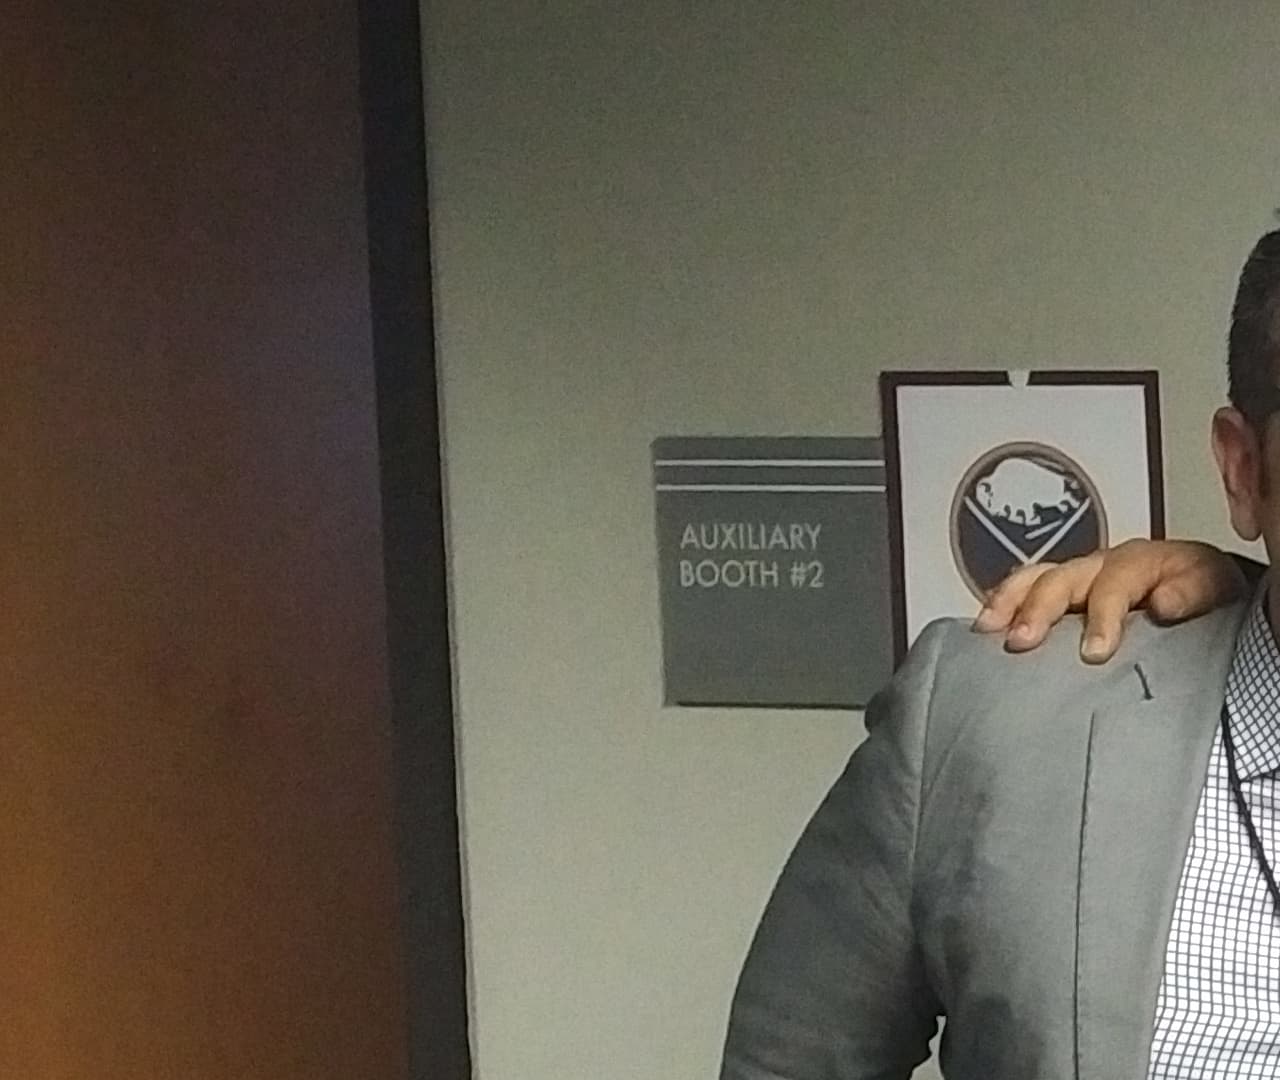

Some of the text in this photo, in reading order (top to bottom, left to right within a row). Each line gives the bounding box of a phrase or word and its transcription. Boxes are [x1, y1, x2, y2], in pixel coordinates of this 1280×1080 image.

[680, 523, 822, 550] AUXILIARY
[679, 559, 825, 588] BOOTH #2
